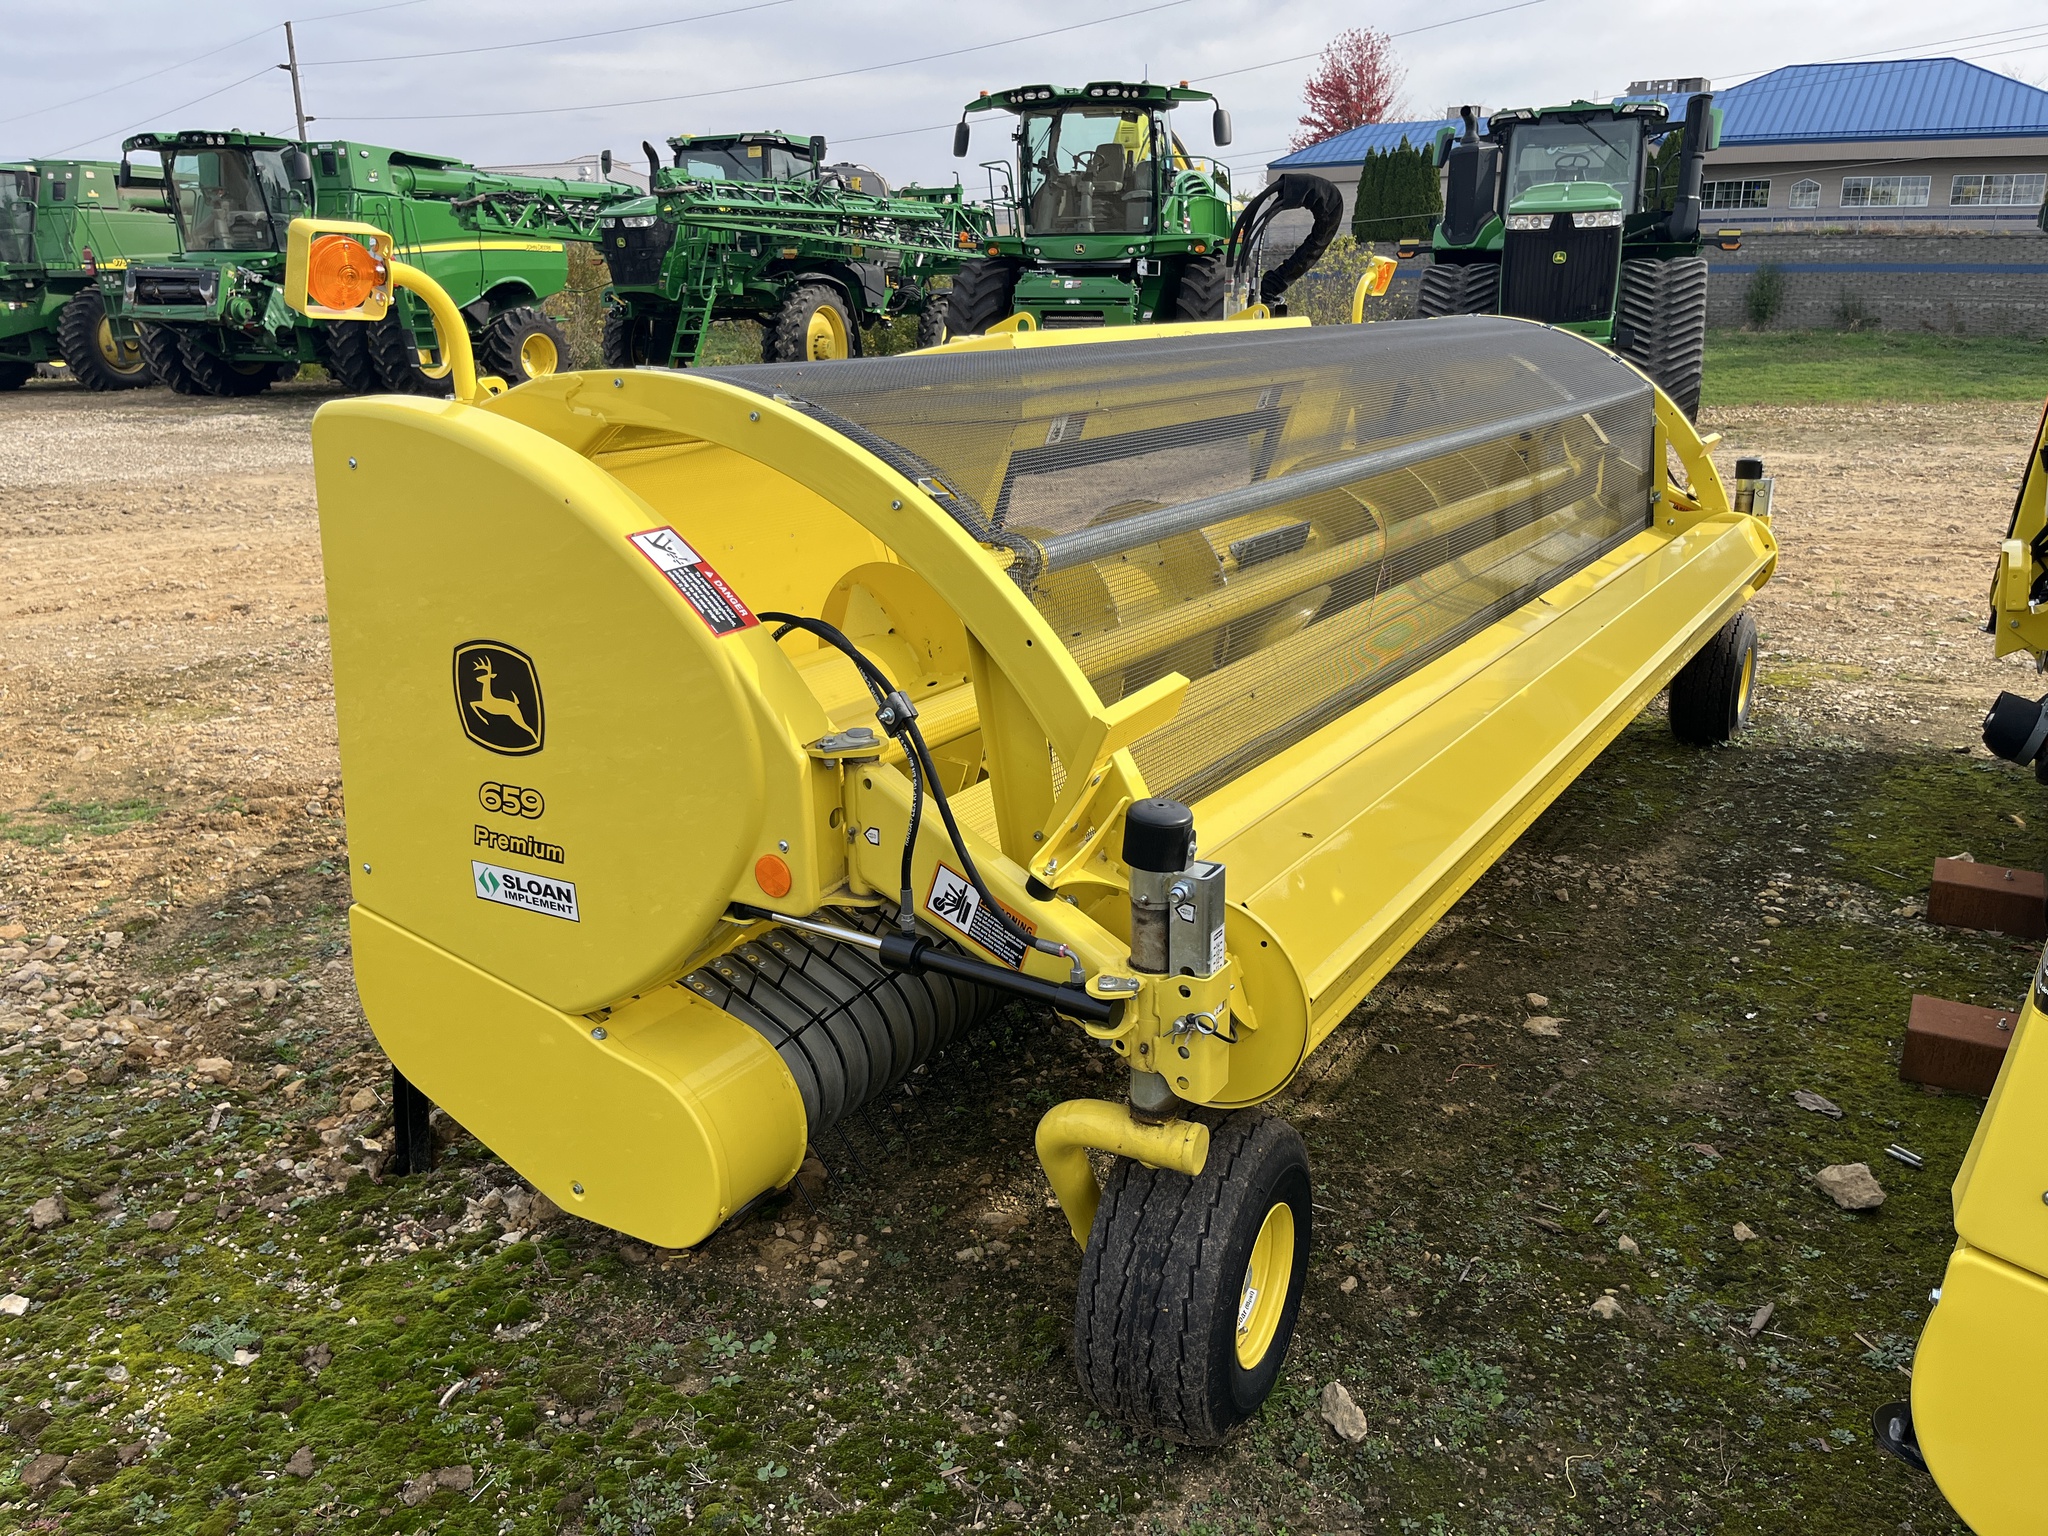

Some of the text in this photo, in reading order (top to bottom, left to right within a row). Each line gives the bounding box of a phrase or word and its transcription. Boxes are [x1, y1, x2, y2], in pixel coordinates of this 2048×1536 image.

[714, 580, 748, 616] DANGER
[478, 780, 545, 820] 659
[904, 802, 918, 847] HANSA-FLEX
[474, 825, 566, 864] Premium
[502, 873, 573, 904] SLOAN
[504, 889, 574, 916] IMPLEMENT
